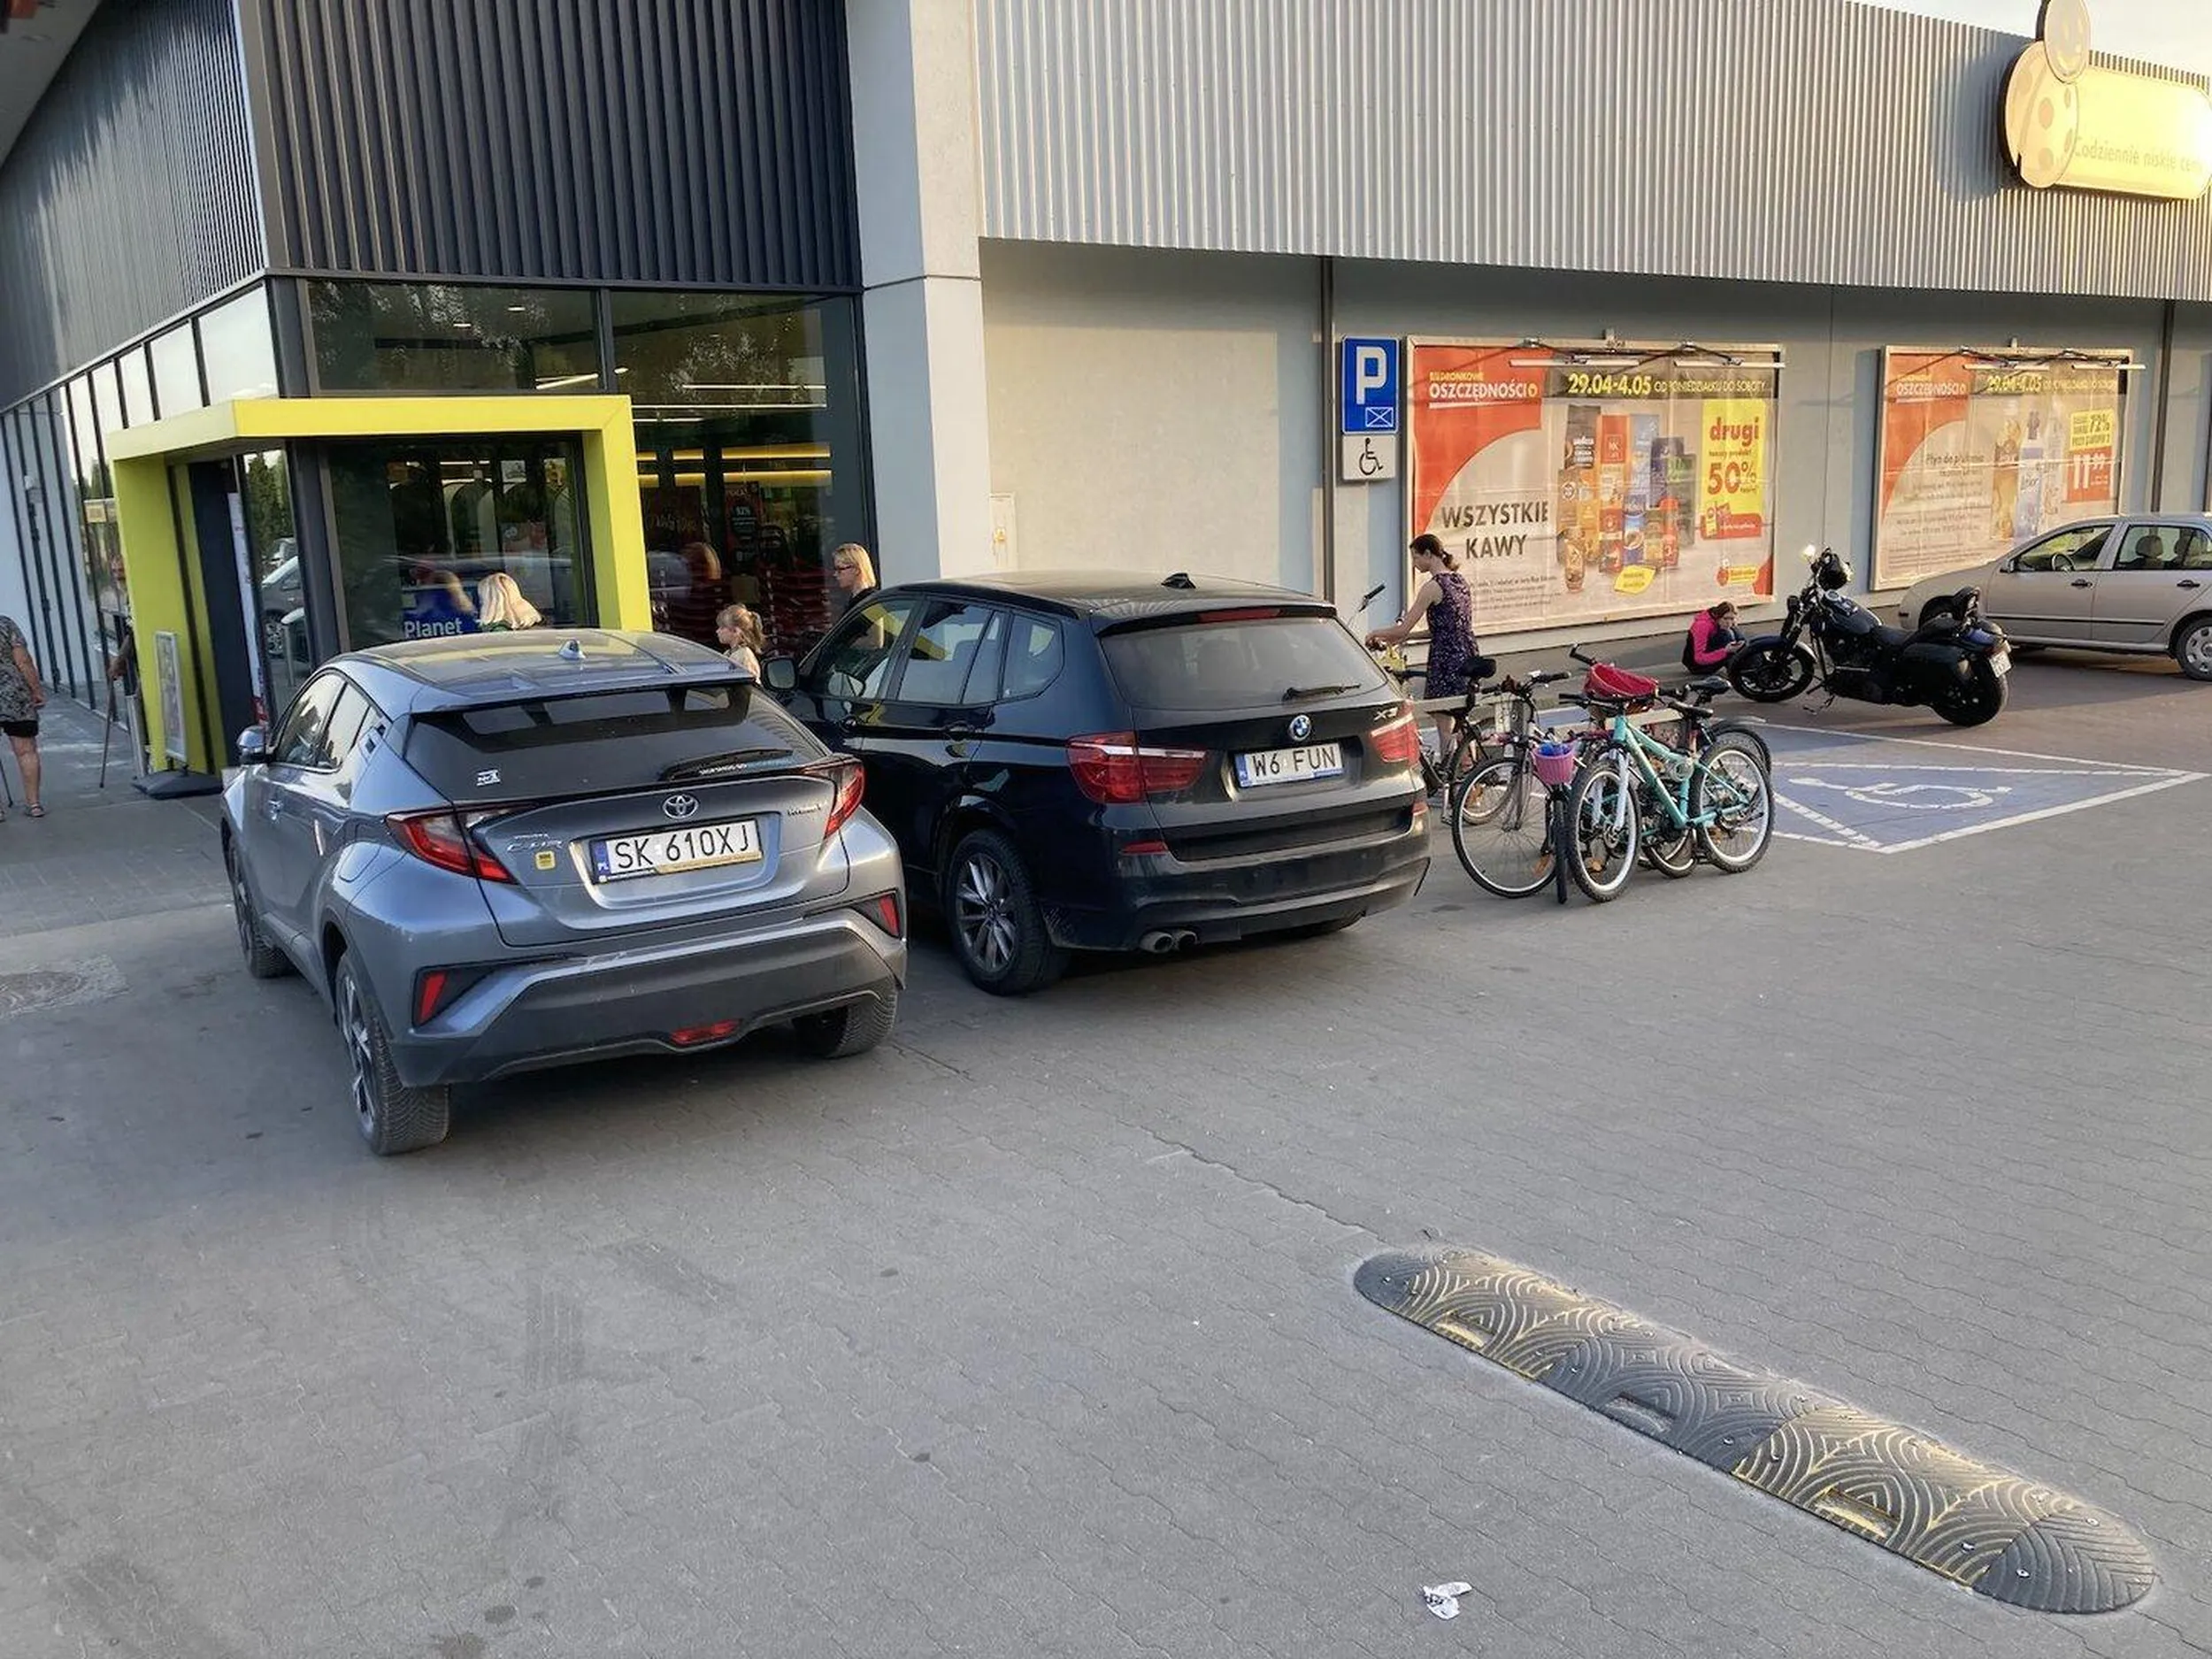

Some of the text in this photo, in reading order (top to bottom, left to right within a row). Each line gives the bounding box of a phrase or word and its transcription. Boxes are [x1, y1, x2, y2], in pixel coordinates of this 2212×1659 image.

[1356, 346, 1387, 405] P
[1568, 373, 1652, 396] 29.04-4.05
[1429, 380, 1527, 401] OSZCZĘDNOŚCI
[1709, 416, 1760, 448] drugi
[1708, 460, 1757, 495] 50%
[1442, 500, 1548, 528] WSZYSTKIE
[1465, 534, 1527, 559] KAWY
[404, 618, 464, 639] Planet
[1252, 746, 1337, 777] W6 FUN
[615, 838, 654, 869] SK
[665, 824, 749, 862] 610XJ
